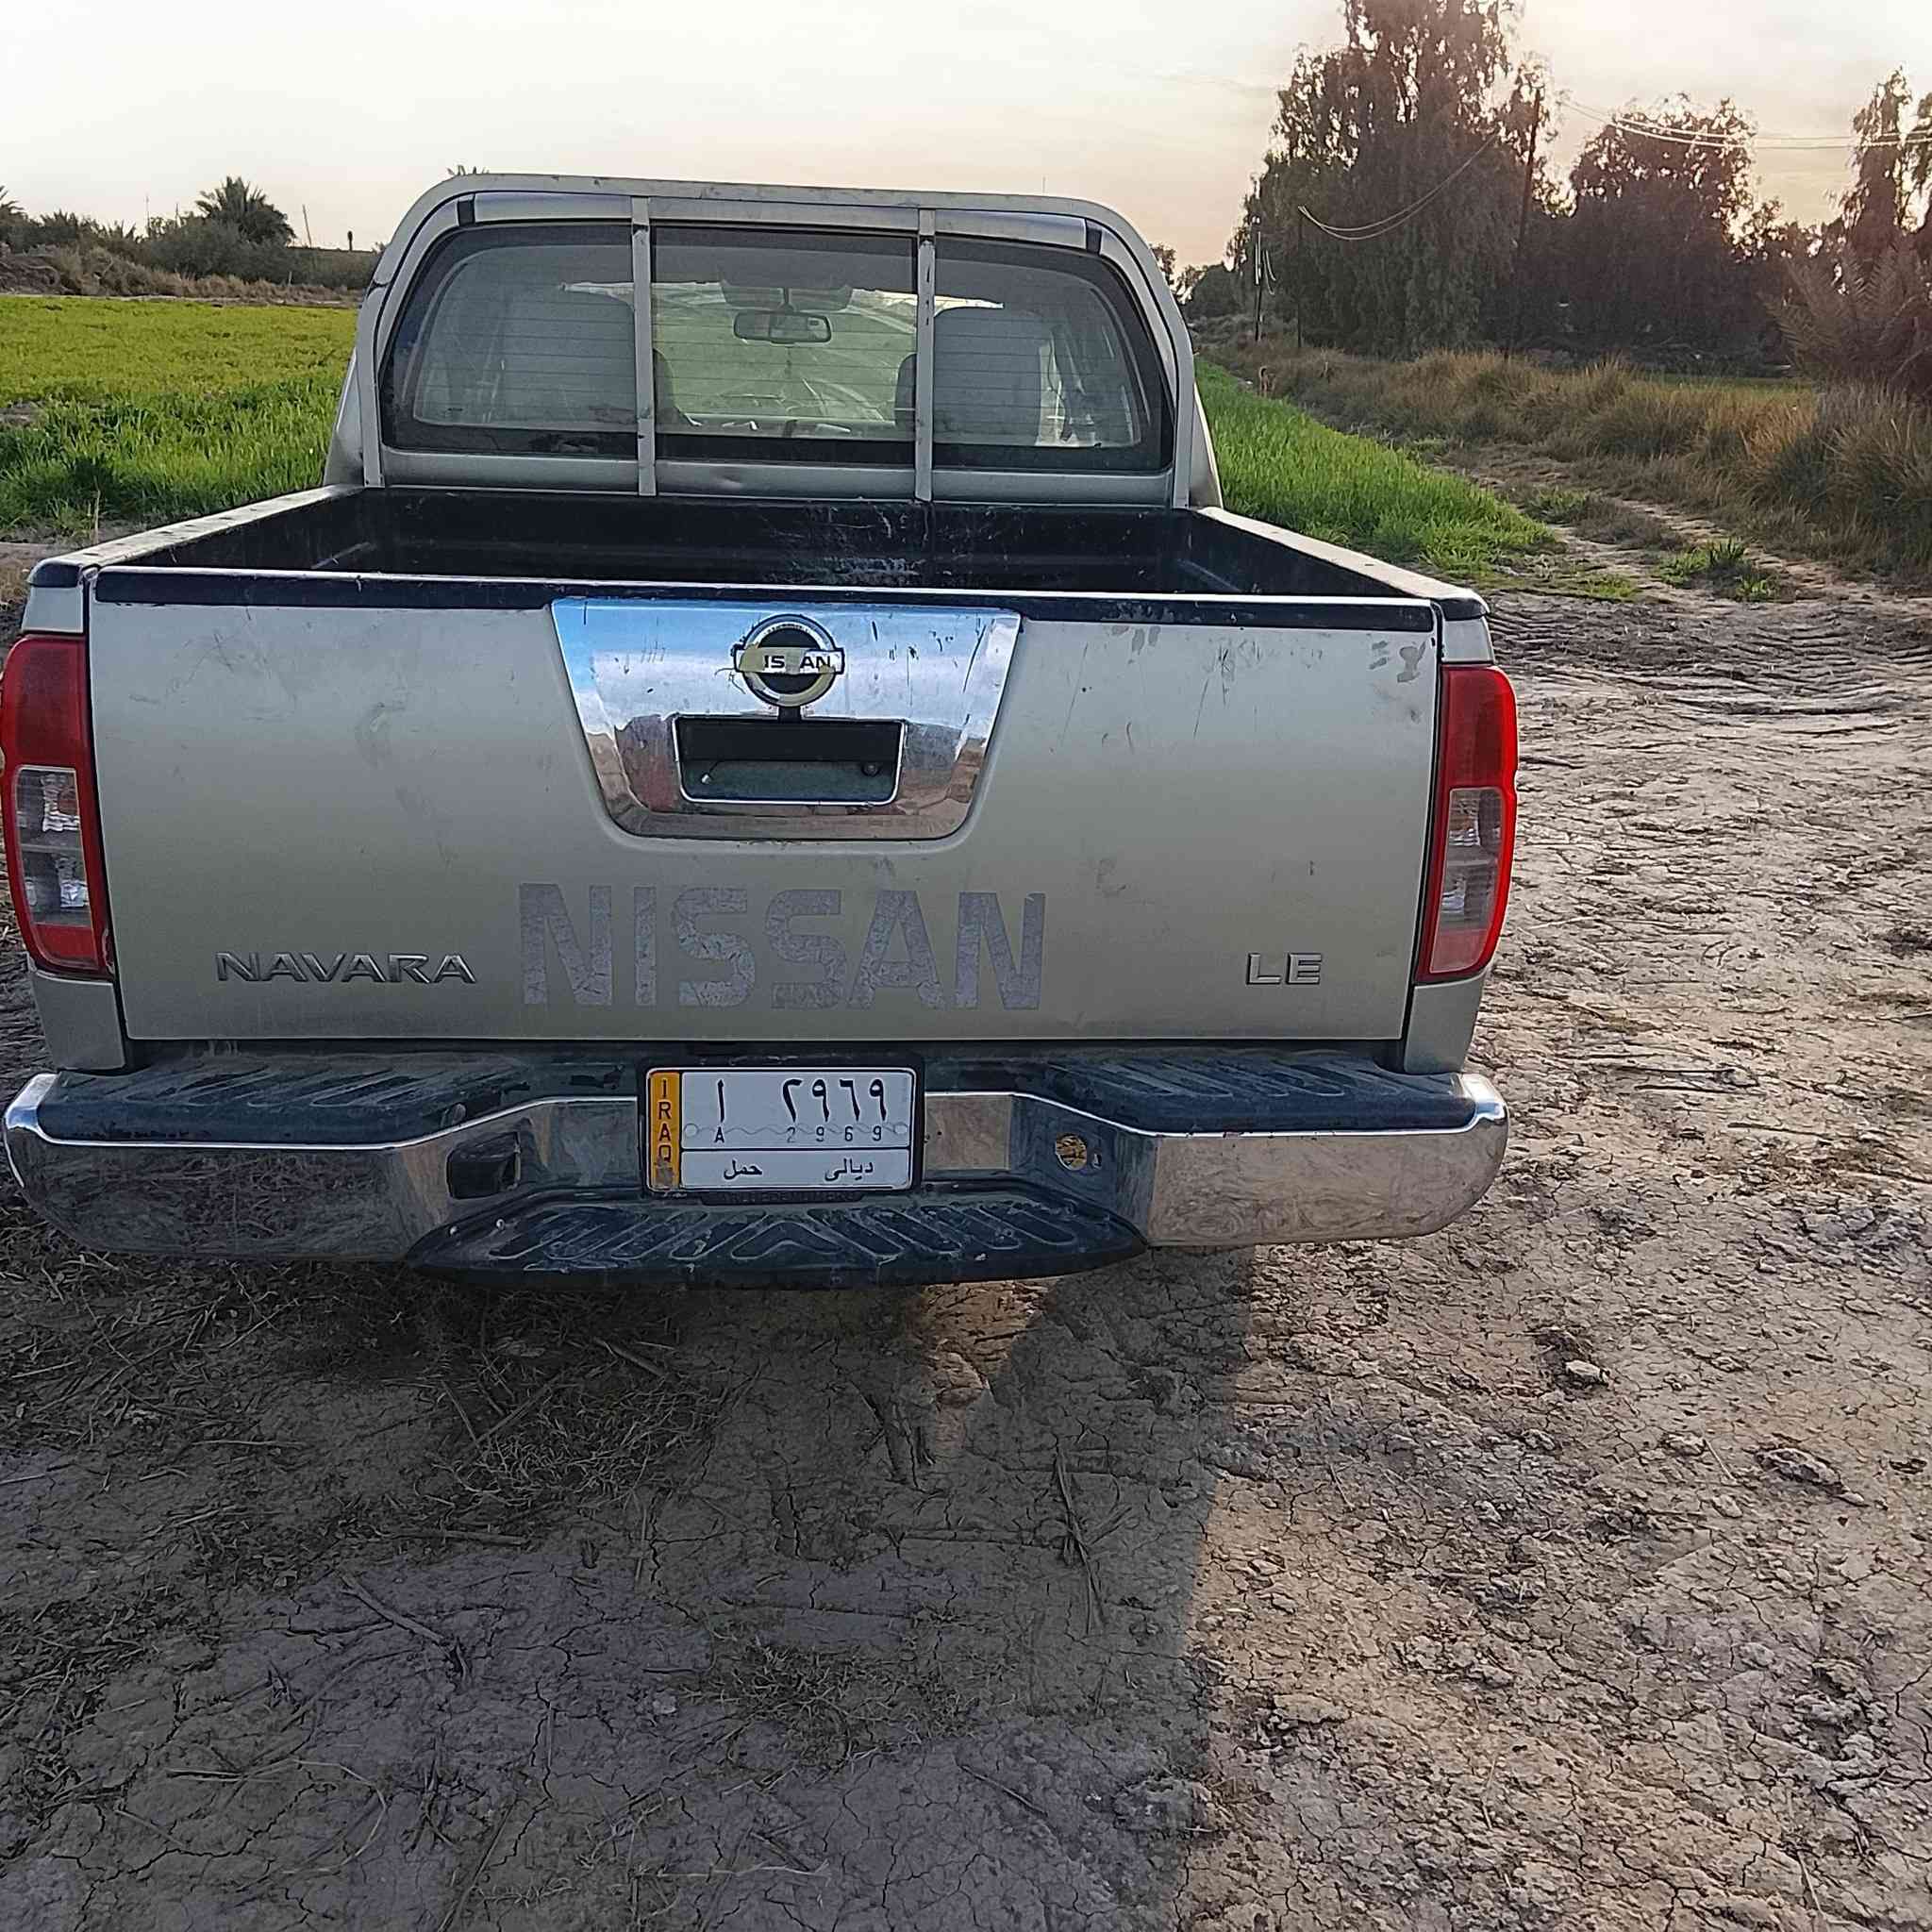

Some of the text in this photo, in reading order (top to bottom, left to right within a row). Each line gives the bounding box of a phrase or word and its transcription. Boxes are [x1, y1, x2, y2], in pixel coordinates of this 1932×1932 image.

[760, 655, 831, 669] ISAN
[519, 883, 1045, 1009] NISSAN
[215, 952, 476, 984] NAVARA
[1246, 953, 1322, 985] LE
[782, 1078, 888, 1123] ٢٩٦٩
[657, 1078, 673, 1163] IRAQ
[714, 1126, 882, 1143] A 2969
[724, 1158, 874, 1180] حمل ديالى
